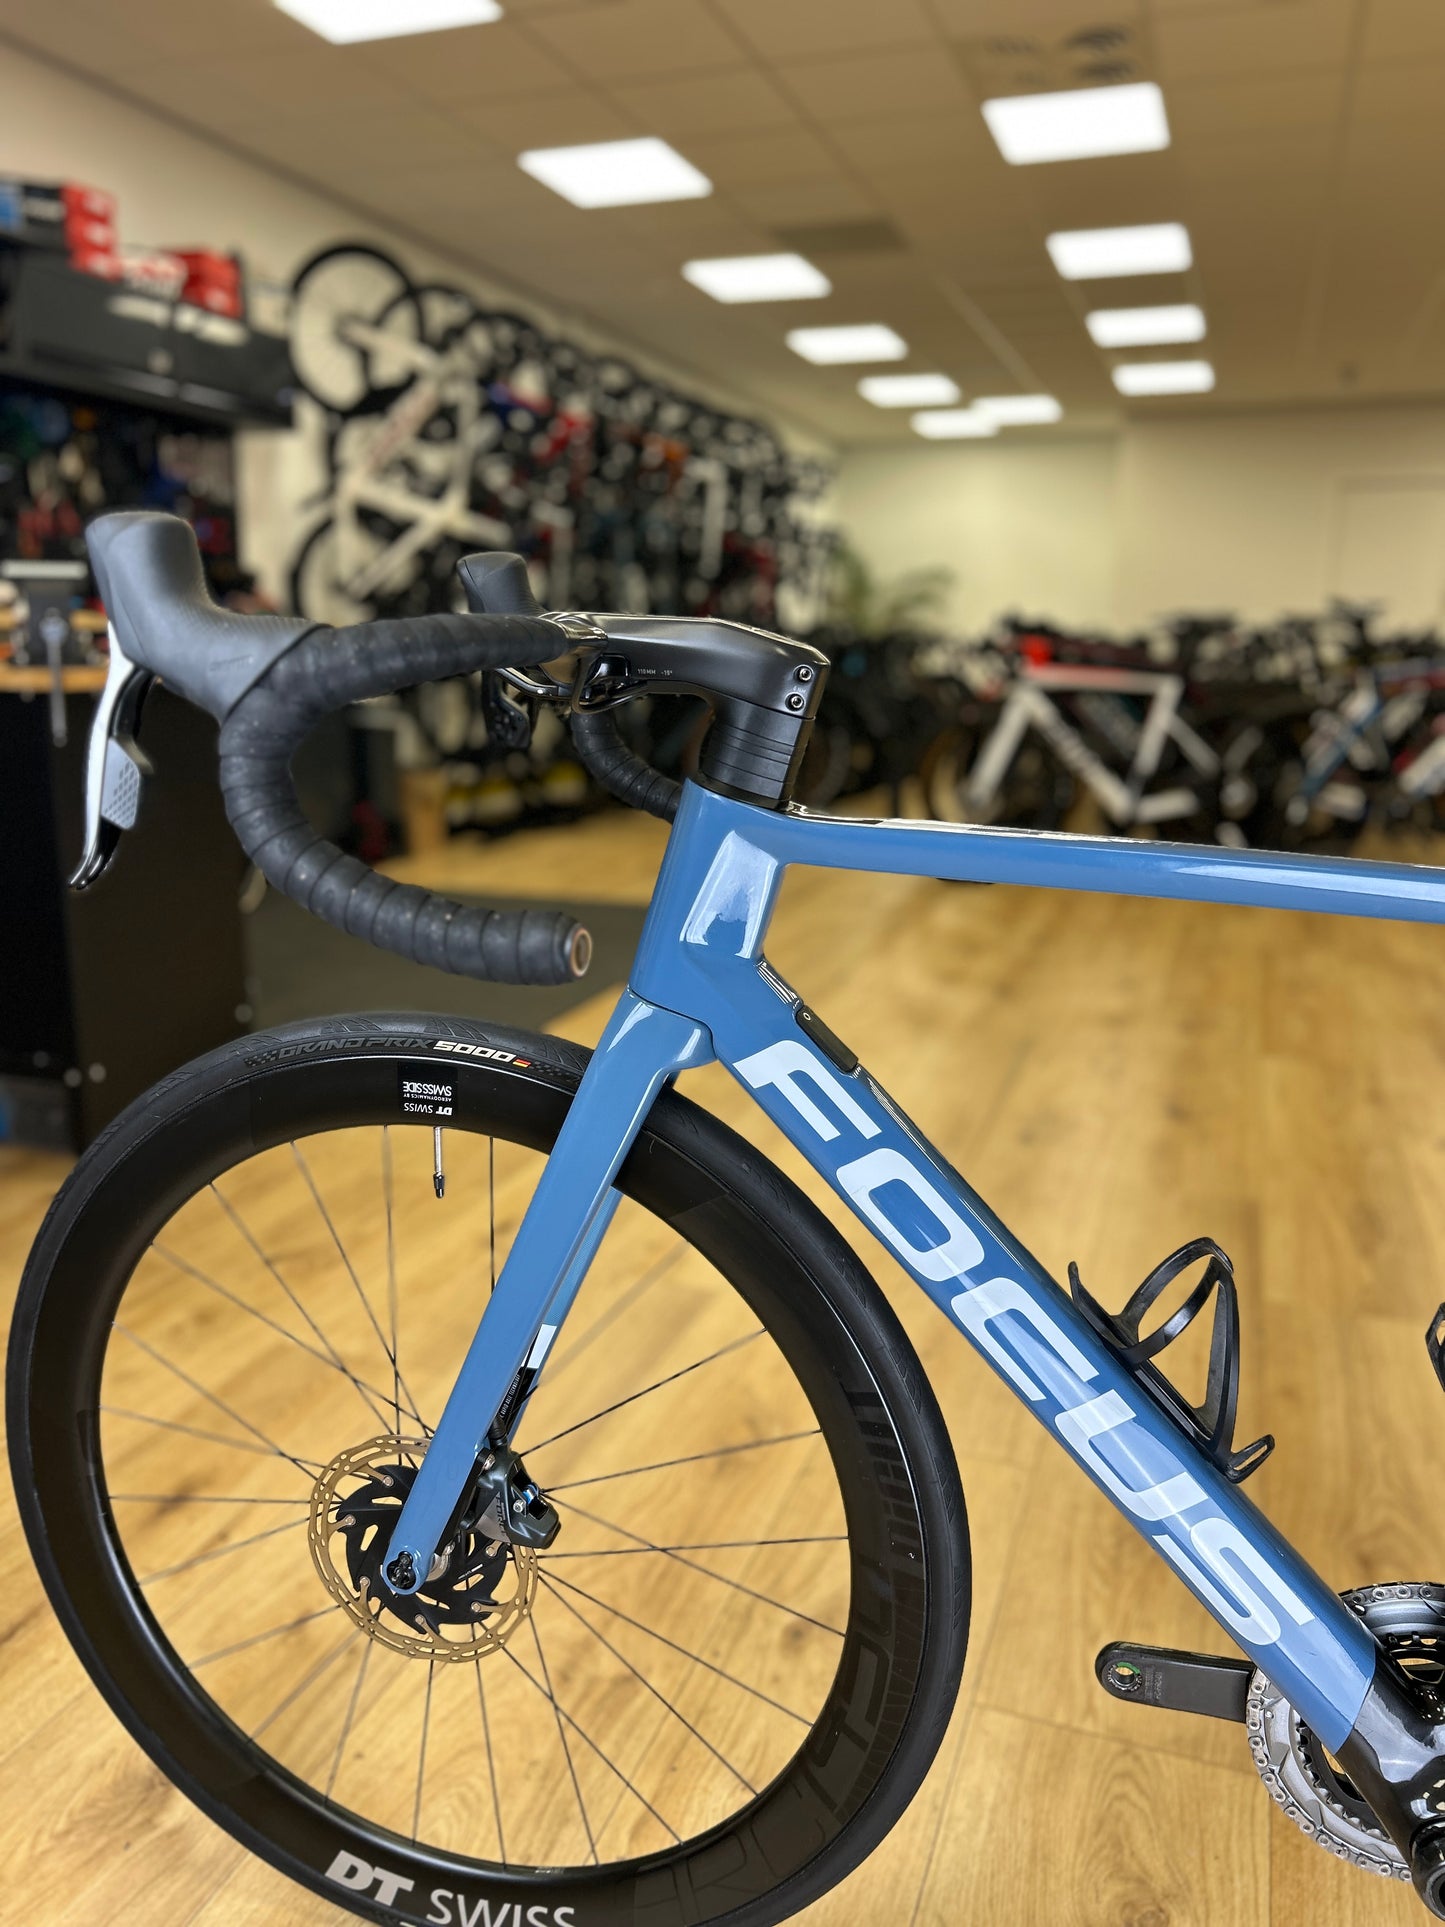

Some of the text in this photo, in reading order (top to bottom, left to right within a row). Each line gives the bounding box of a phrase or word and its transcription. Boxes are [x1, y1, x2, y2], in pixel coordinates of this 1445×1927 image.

[278, 1037, 517, 1063] GRAND PRIX 5000
[403, 1102, 453, 1116] DT SWISS
[410, 1093, 452, 1102] AERODYNAMICS
[731, 1039, 1316, 1647] FOCUS
[324, 1850, 416, 1907] DT
